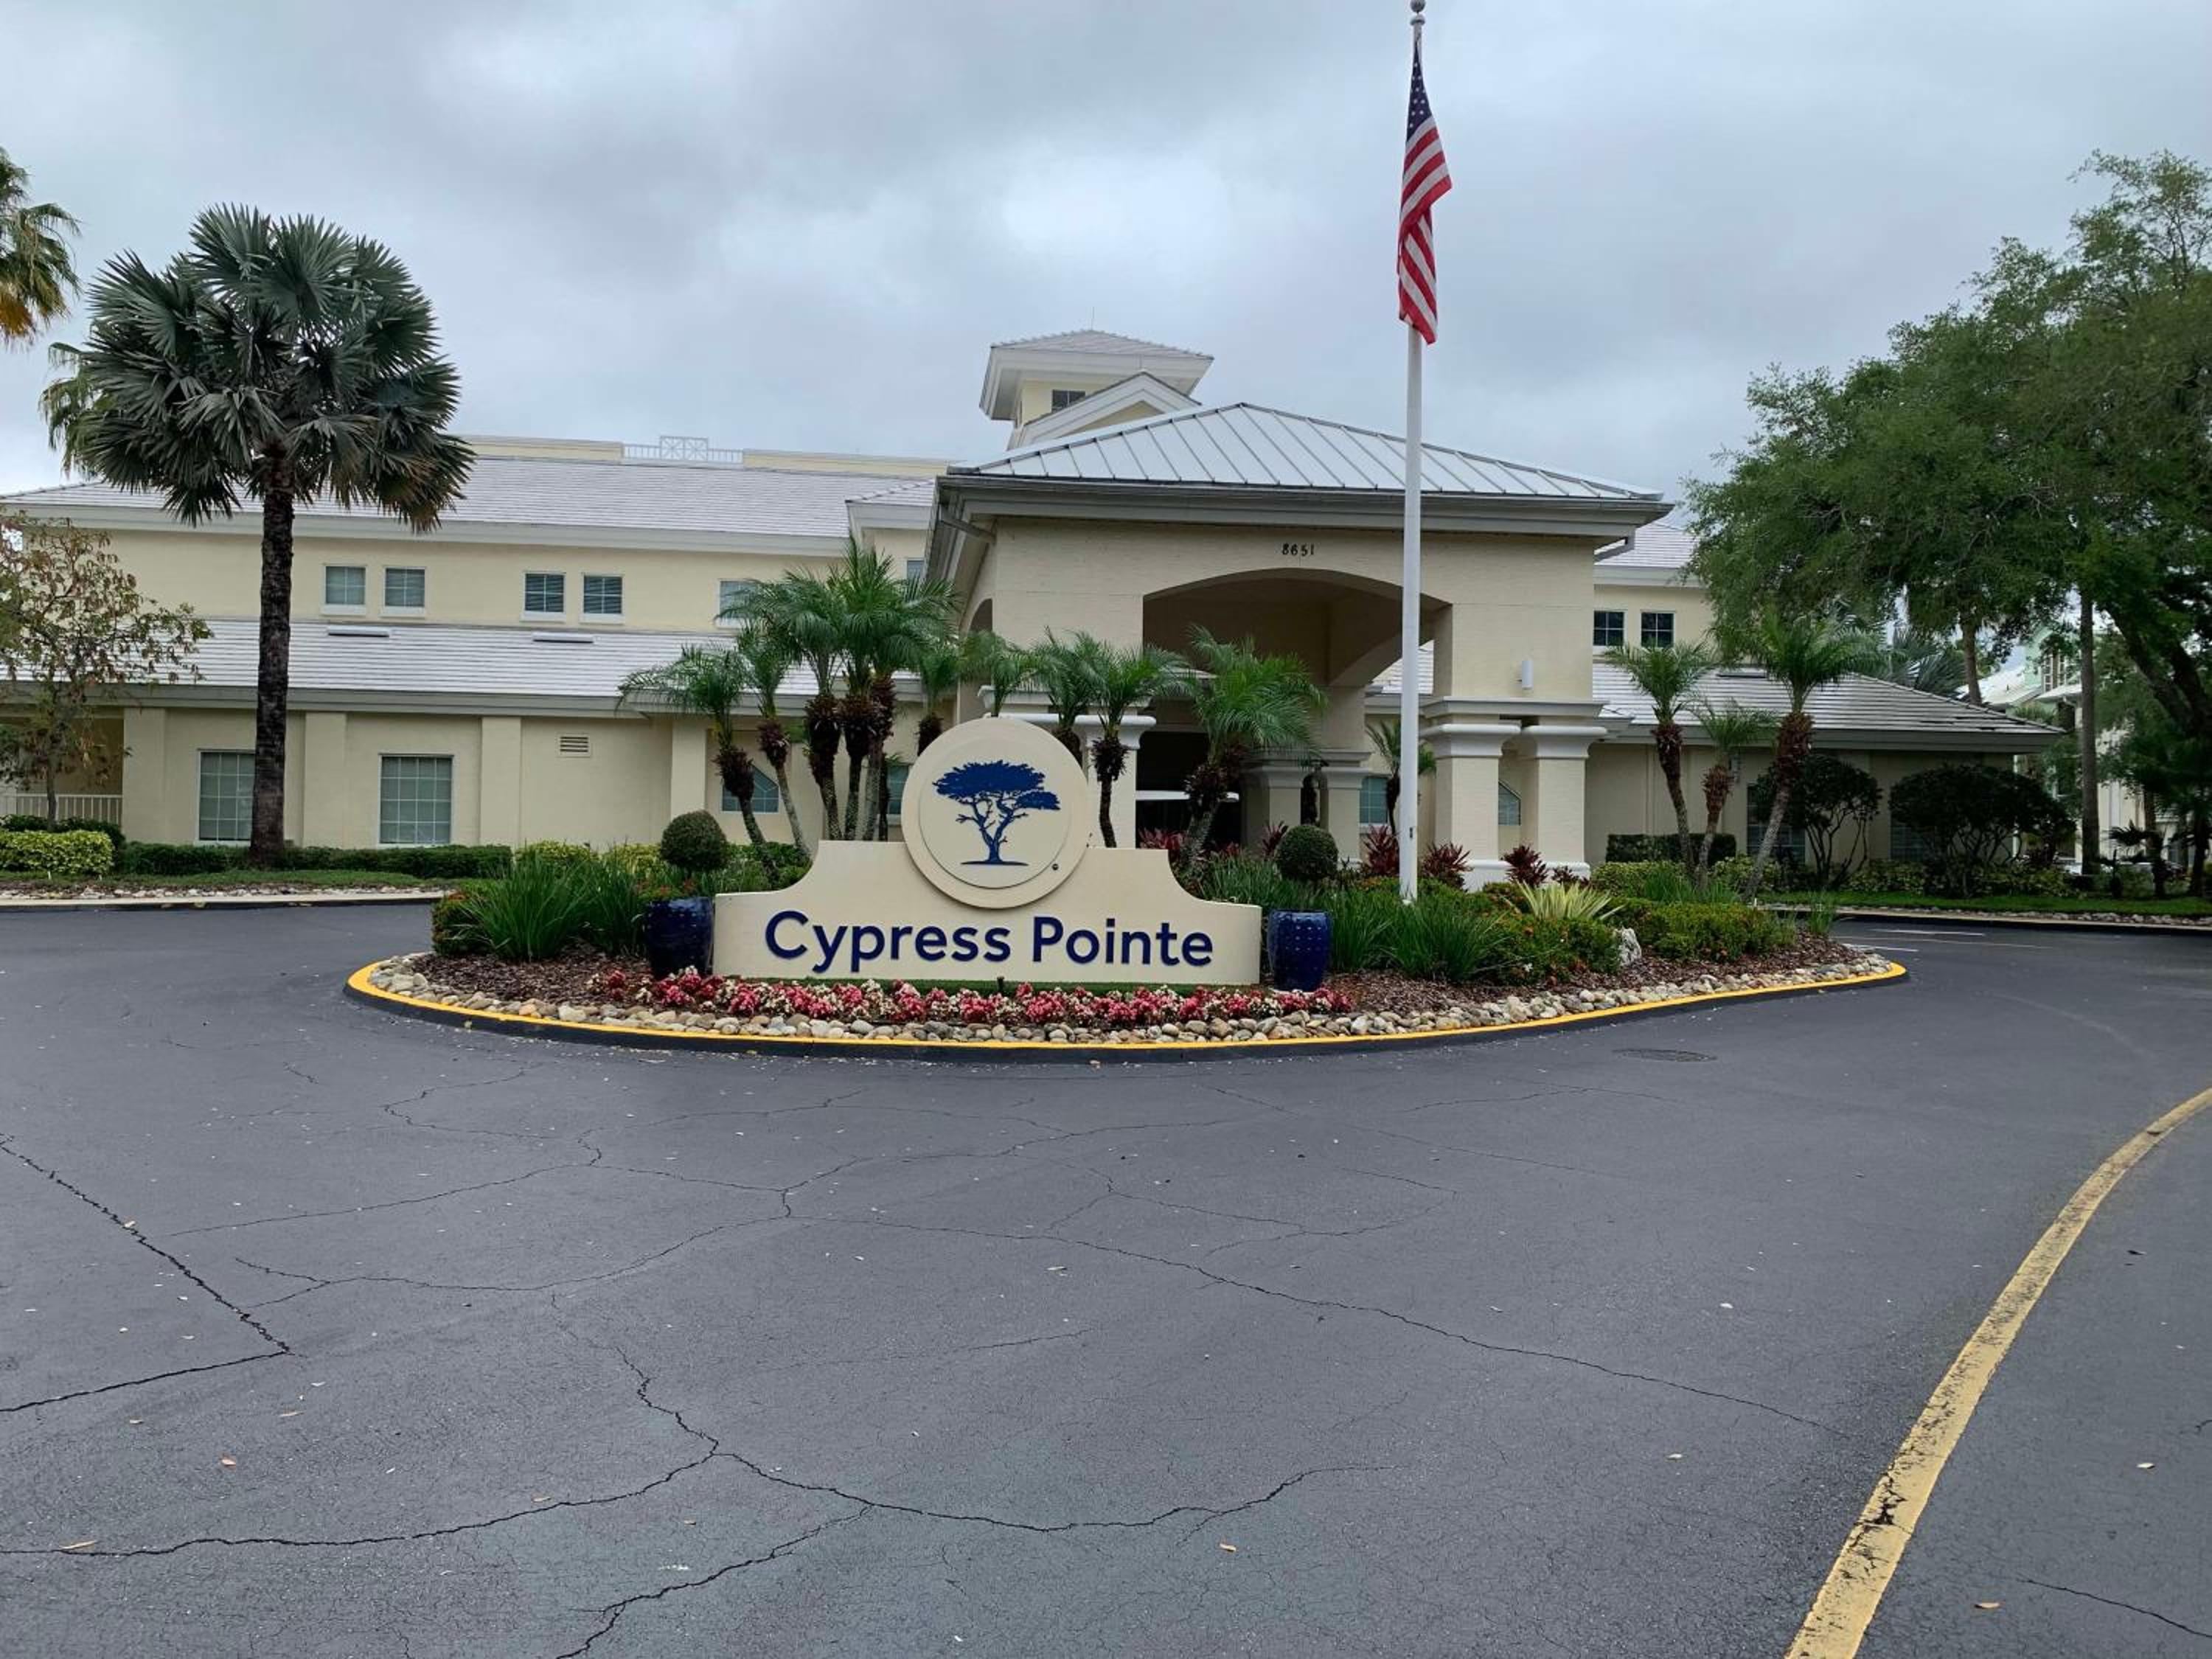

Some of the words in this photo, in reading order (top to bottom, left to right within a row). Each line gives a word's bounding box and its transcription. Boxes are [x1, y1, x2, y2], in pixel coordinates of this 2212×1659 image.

[1281, 543, 1315, 557] 8651
[765, 910, 1011, 973] Cypress
[1033, 916, 1212, 967] Pointe
